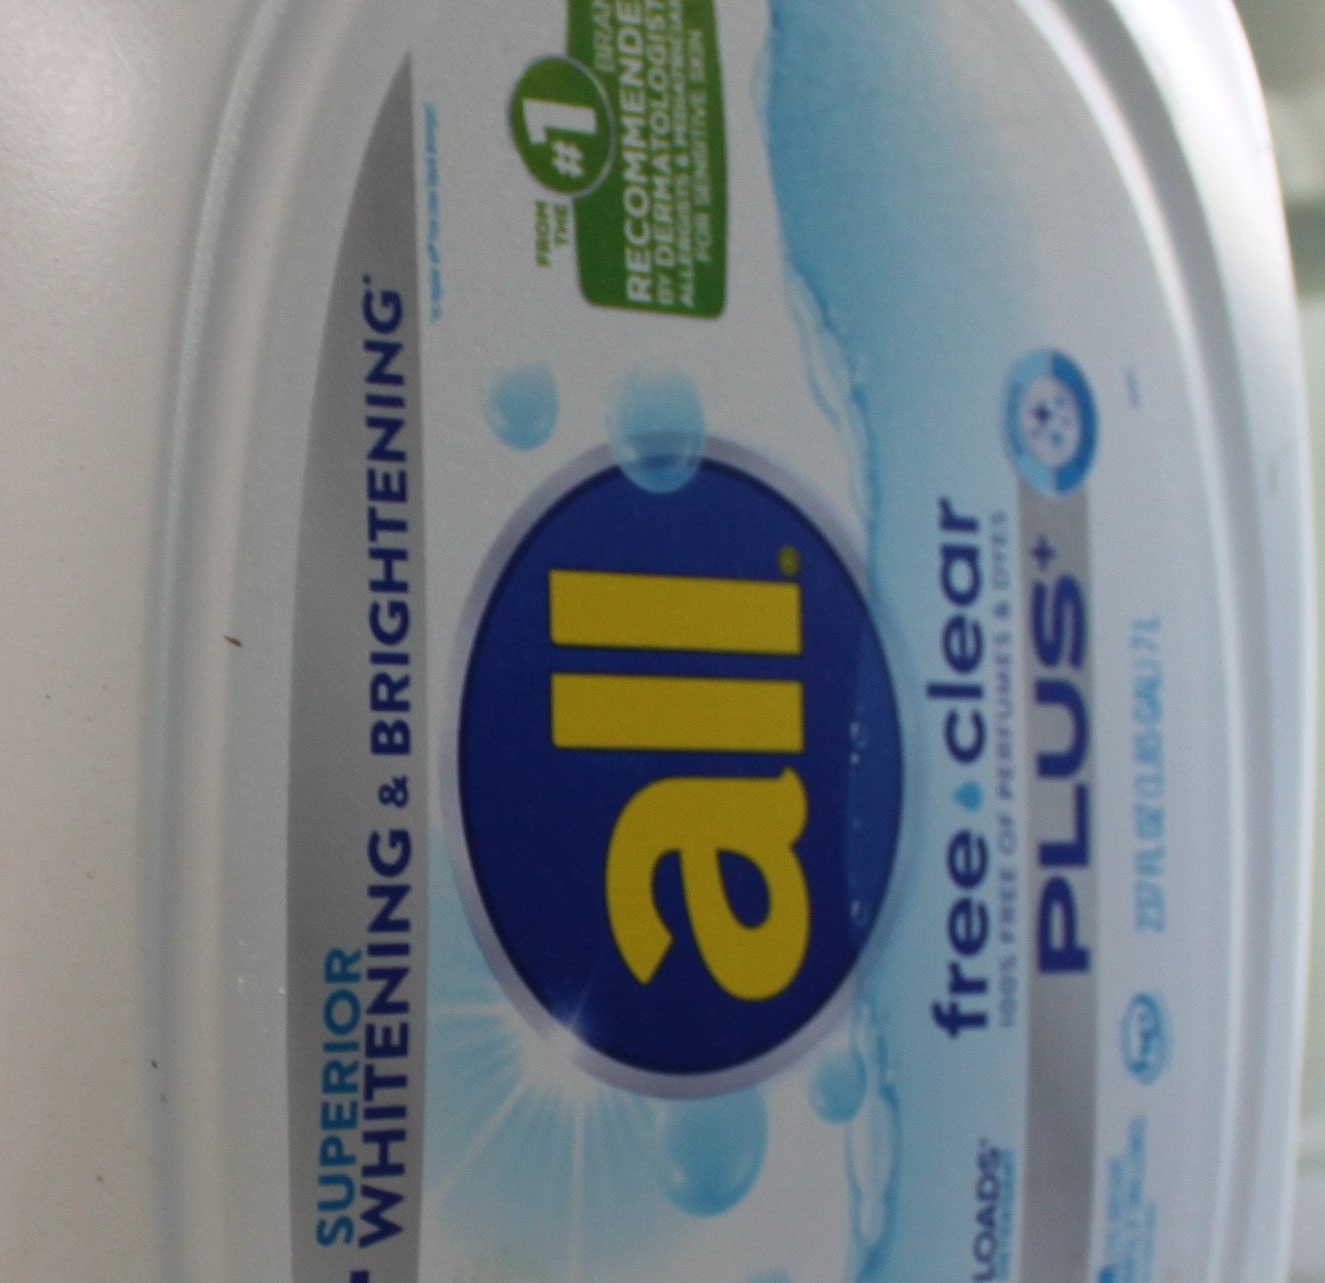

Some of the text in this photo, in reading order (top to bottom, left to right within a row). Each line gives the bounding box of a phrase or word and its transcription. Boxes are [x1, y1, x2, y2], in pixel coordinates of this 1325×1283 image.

[522, 96, 599, 180] #1
[378, 774, 409, 808] &
[548, 568, 812, 1001] all
[923, 495, 992, 1040] free clear
[992, 632, 1014, 800] PERFUMES
[994, 811, 1016, 855] OF
[995, 867, 1017, 945] FREE
[316, 948, 362, 1248] SUPERIOR
[358, 829, 412, 1248] WHITENING
